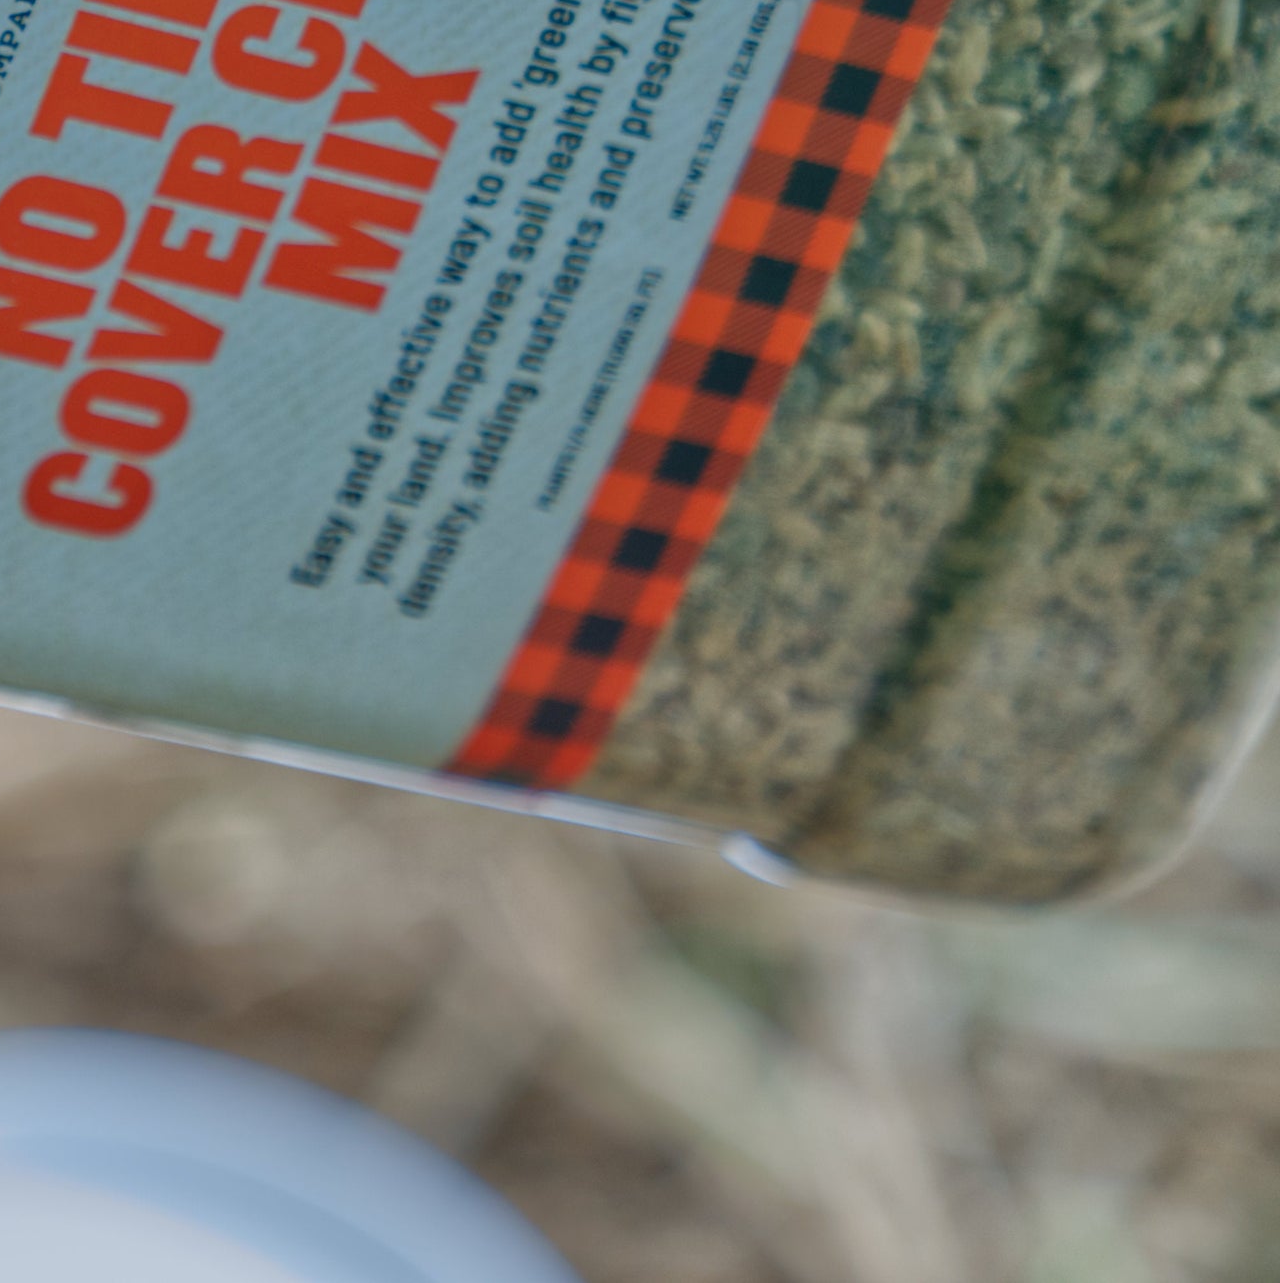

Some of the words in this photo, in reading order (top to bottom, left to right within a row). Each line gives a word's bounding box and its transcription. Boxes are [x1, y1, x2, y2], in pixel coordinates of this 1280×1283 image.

[578, 32, 629, 76] by
[262, 41, 480, 312] MIX
[528, 84, 604, 193] health
[507, 198, 553, 262] soil
[21, 129, 300, 538] COVER
[290, 514, 356, 588] Easy
[336, 445, 384, 508] and
[367, 293, 454, 441] effective
[436, 216, 493, 285] way
[465, 172, 506, 208] to
[489, 99, 537, 166] add
[397, 502, 482, 618] density,
[463, 380, 541, 489] adding
[517, 218, 606, 373] nutrients
[590, 143, 637, 210] and
[427, 270, 525, 422] Improves
[388, 435, 450, 507] land.
[359, 513, 409, 585] your
